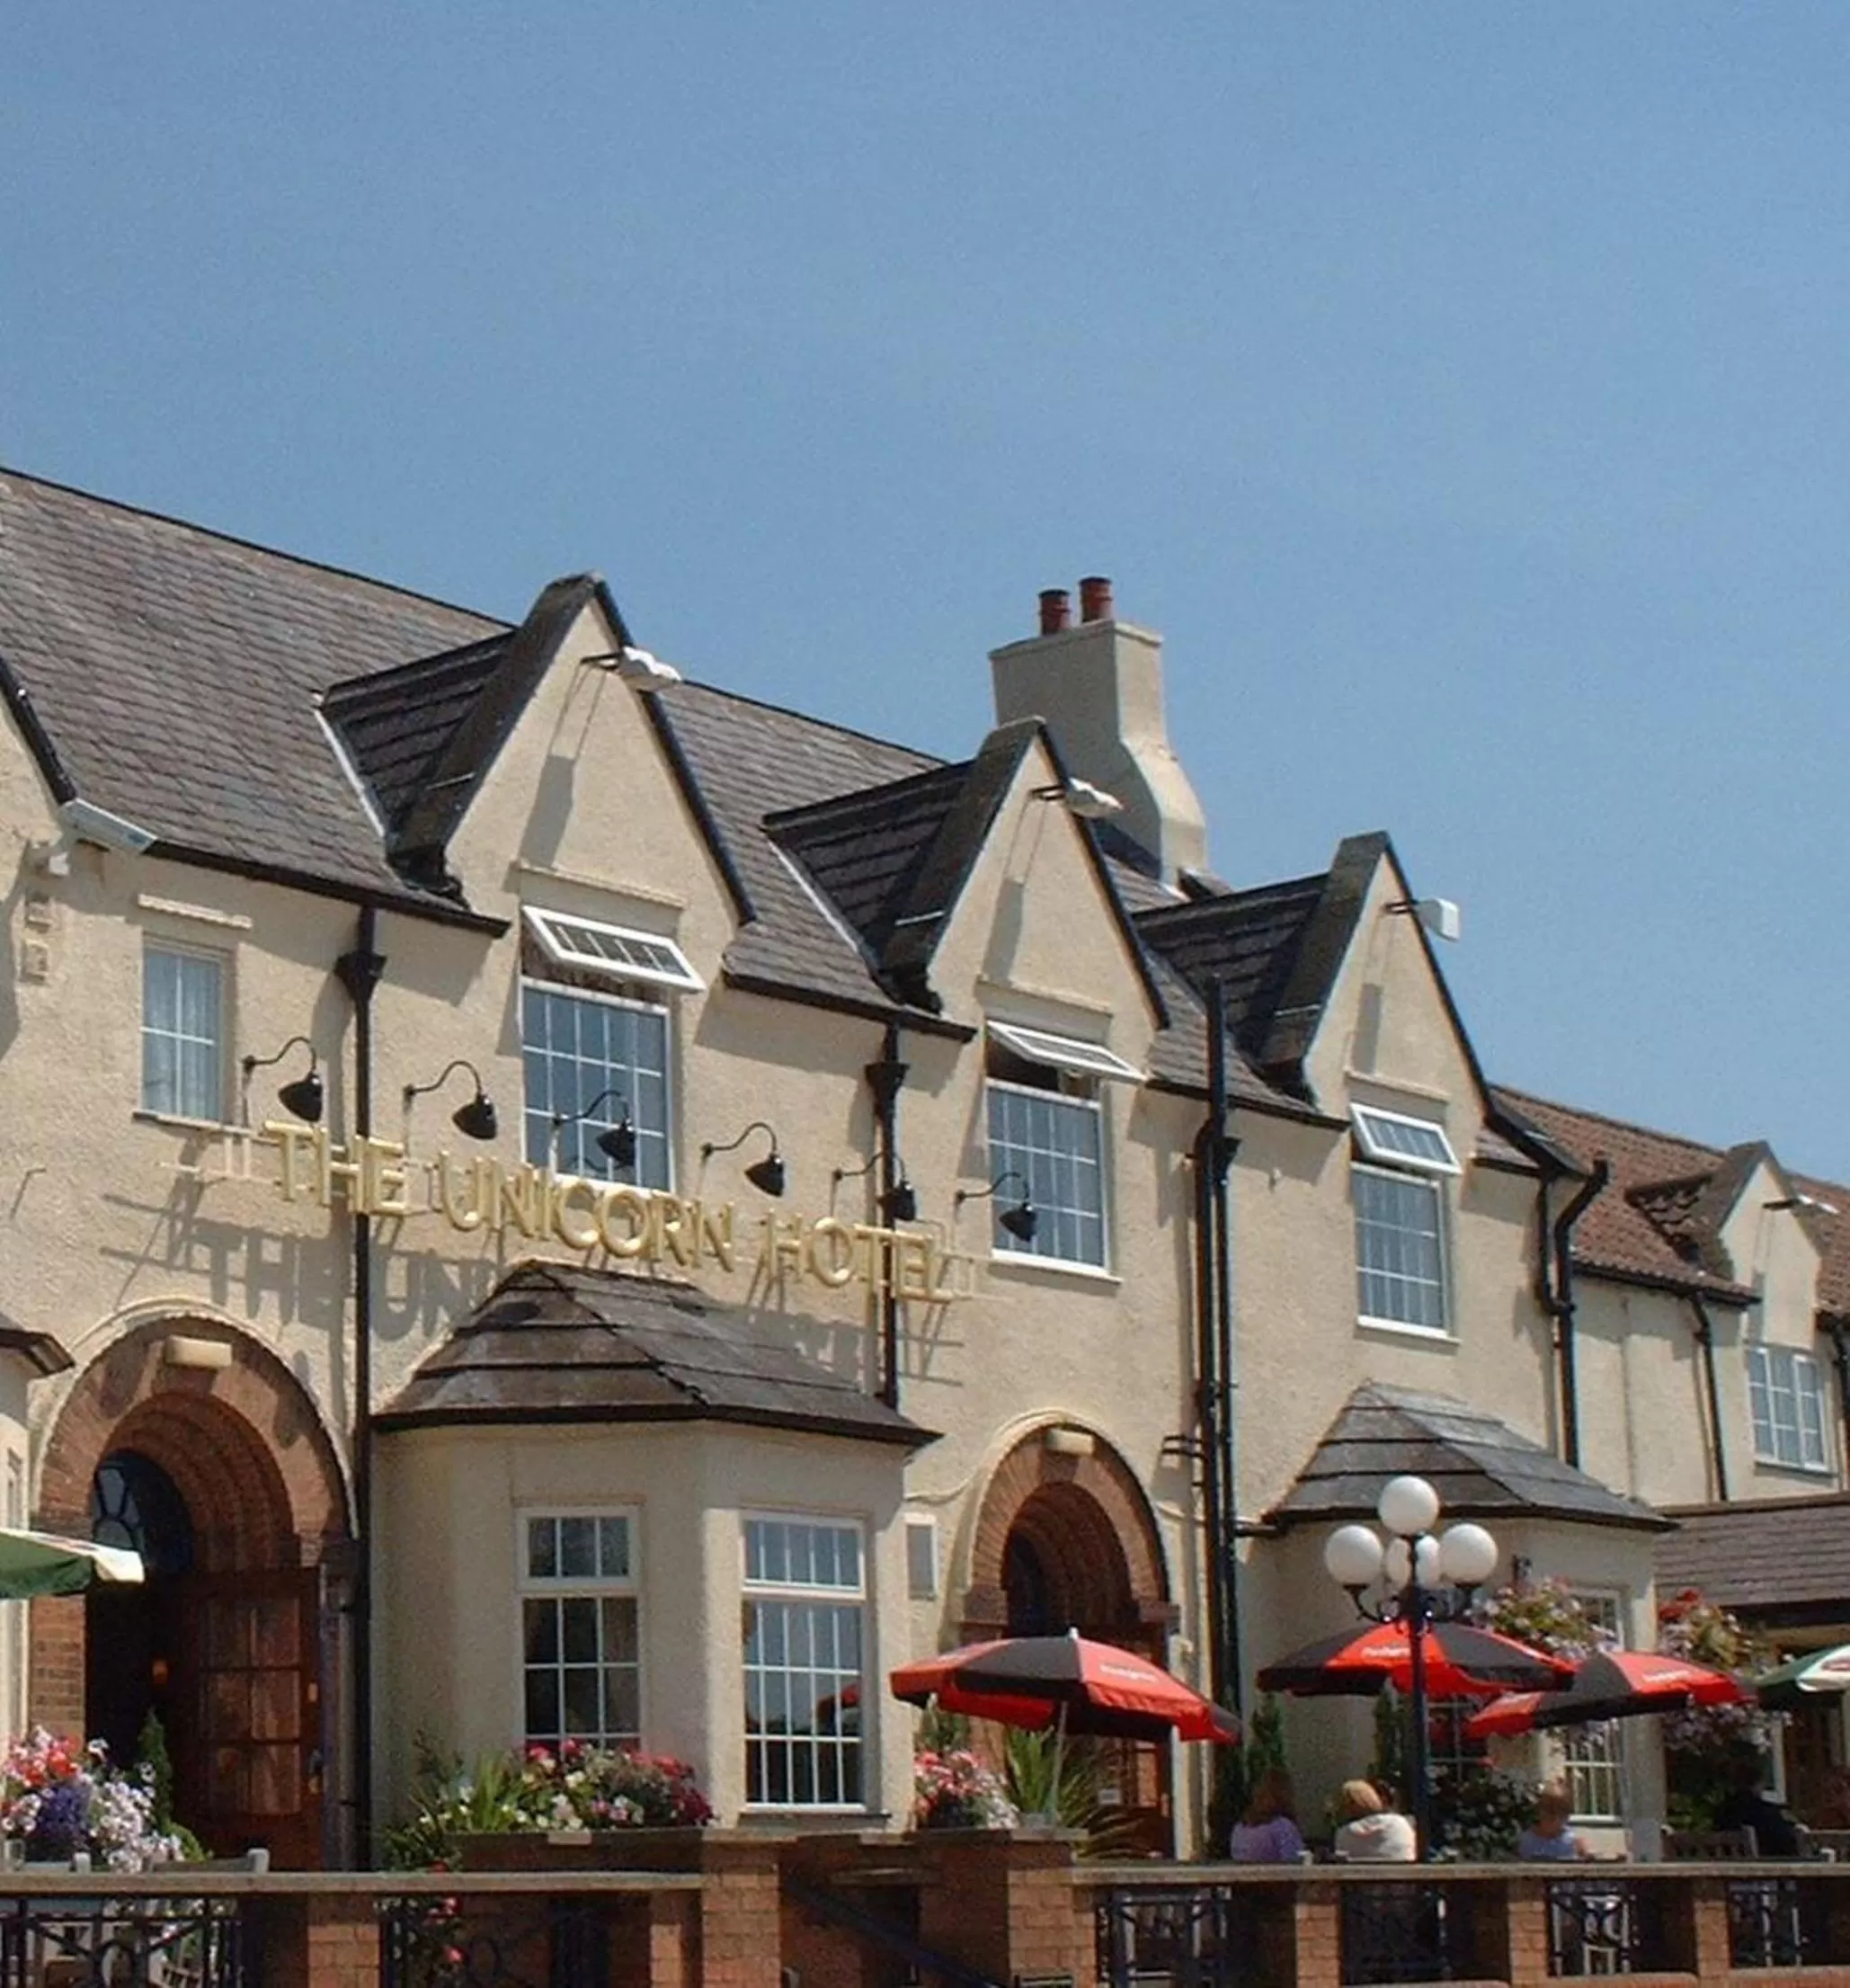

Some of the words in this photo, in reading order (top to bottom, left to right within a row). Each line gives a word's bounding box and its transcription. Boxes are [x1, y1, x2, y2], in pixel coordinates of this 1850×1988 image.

[265, 1120, 406, 1215] THE
[438, 1150, 733, 1272] UNICORN
[766, 1208, 953, 1304] HOTEL
